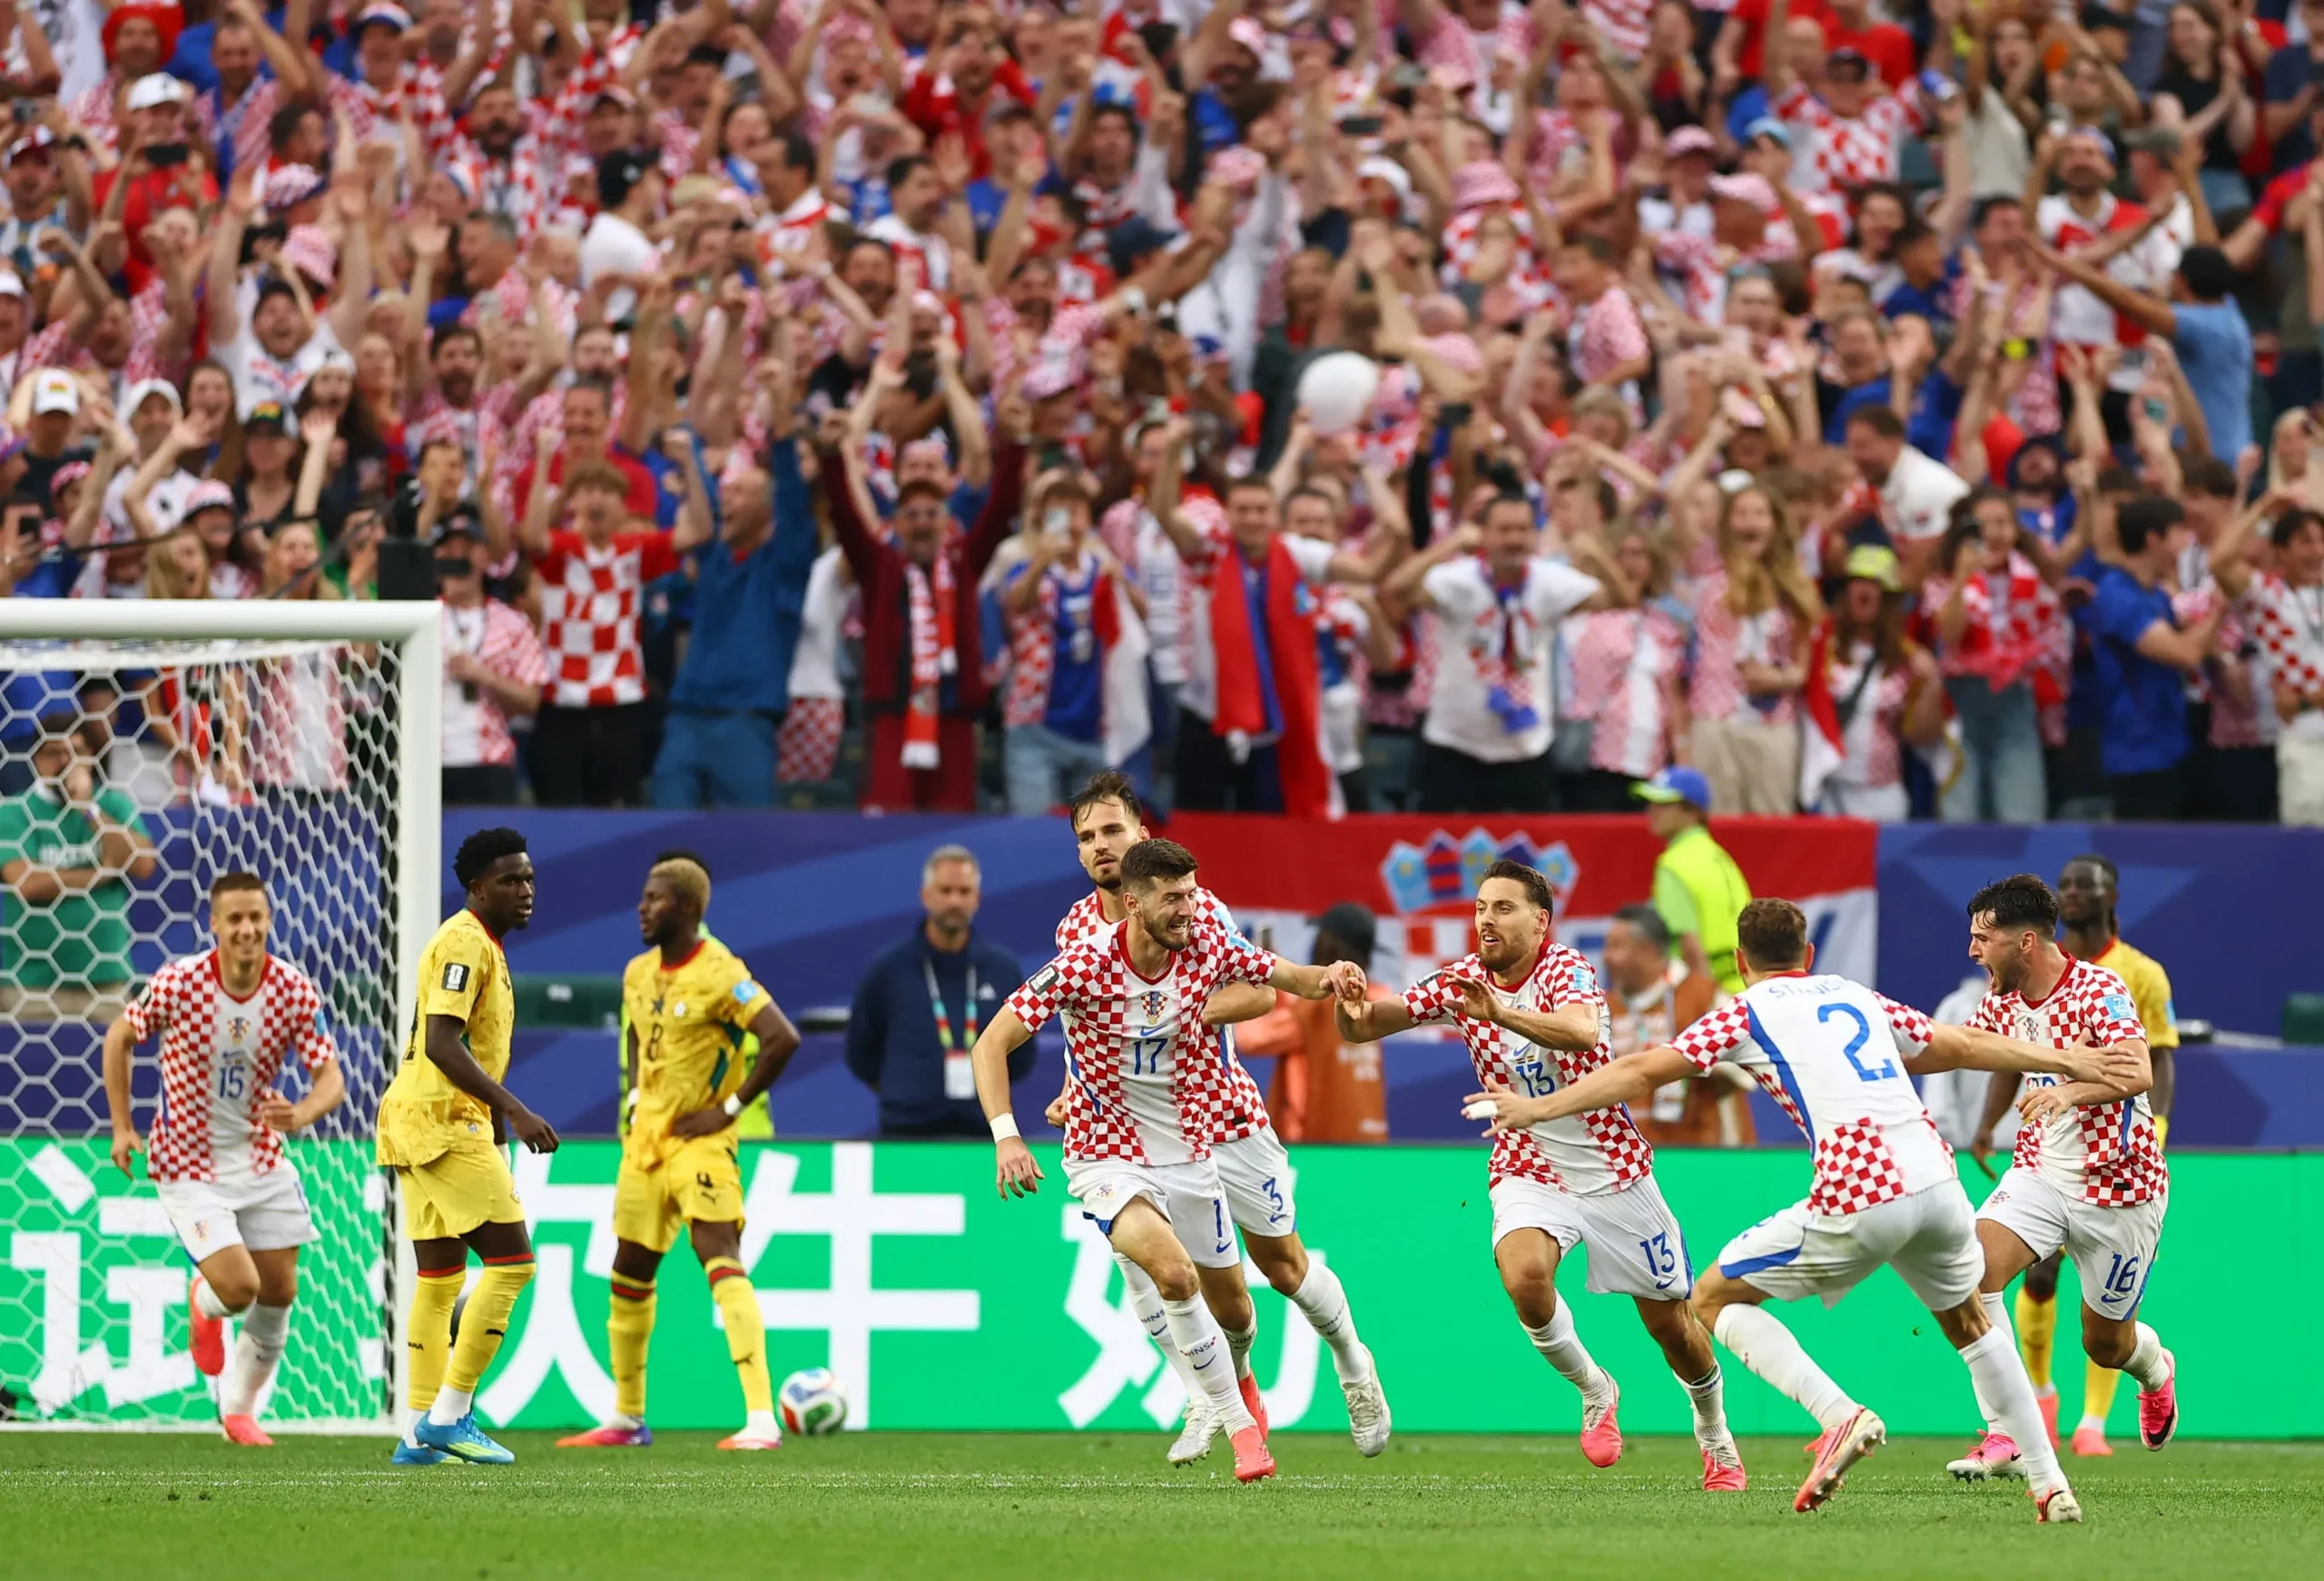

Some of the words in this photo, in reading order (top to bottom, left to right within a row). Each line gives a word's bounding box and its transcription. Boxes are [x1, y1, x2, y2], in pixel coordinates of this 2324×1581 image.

[1133, 1037, 1168, 1075] 17
[1817, 1002, 1898, 1082] 2
[220, 1065, 245, 1100] 15
[1515, 1061, 1556, 1098] 13
[1261, 1177, 1285, 1212] 3
[1639, 1231, 1676, 1277] 13
[2104, 1252, 2140, 1292] 16
[1186, 1341, 1211, 1358] HNS
